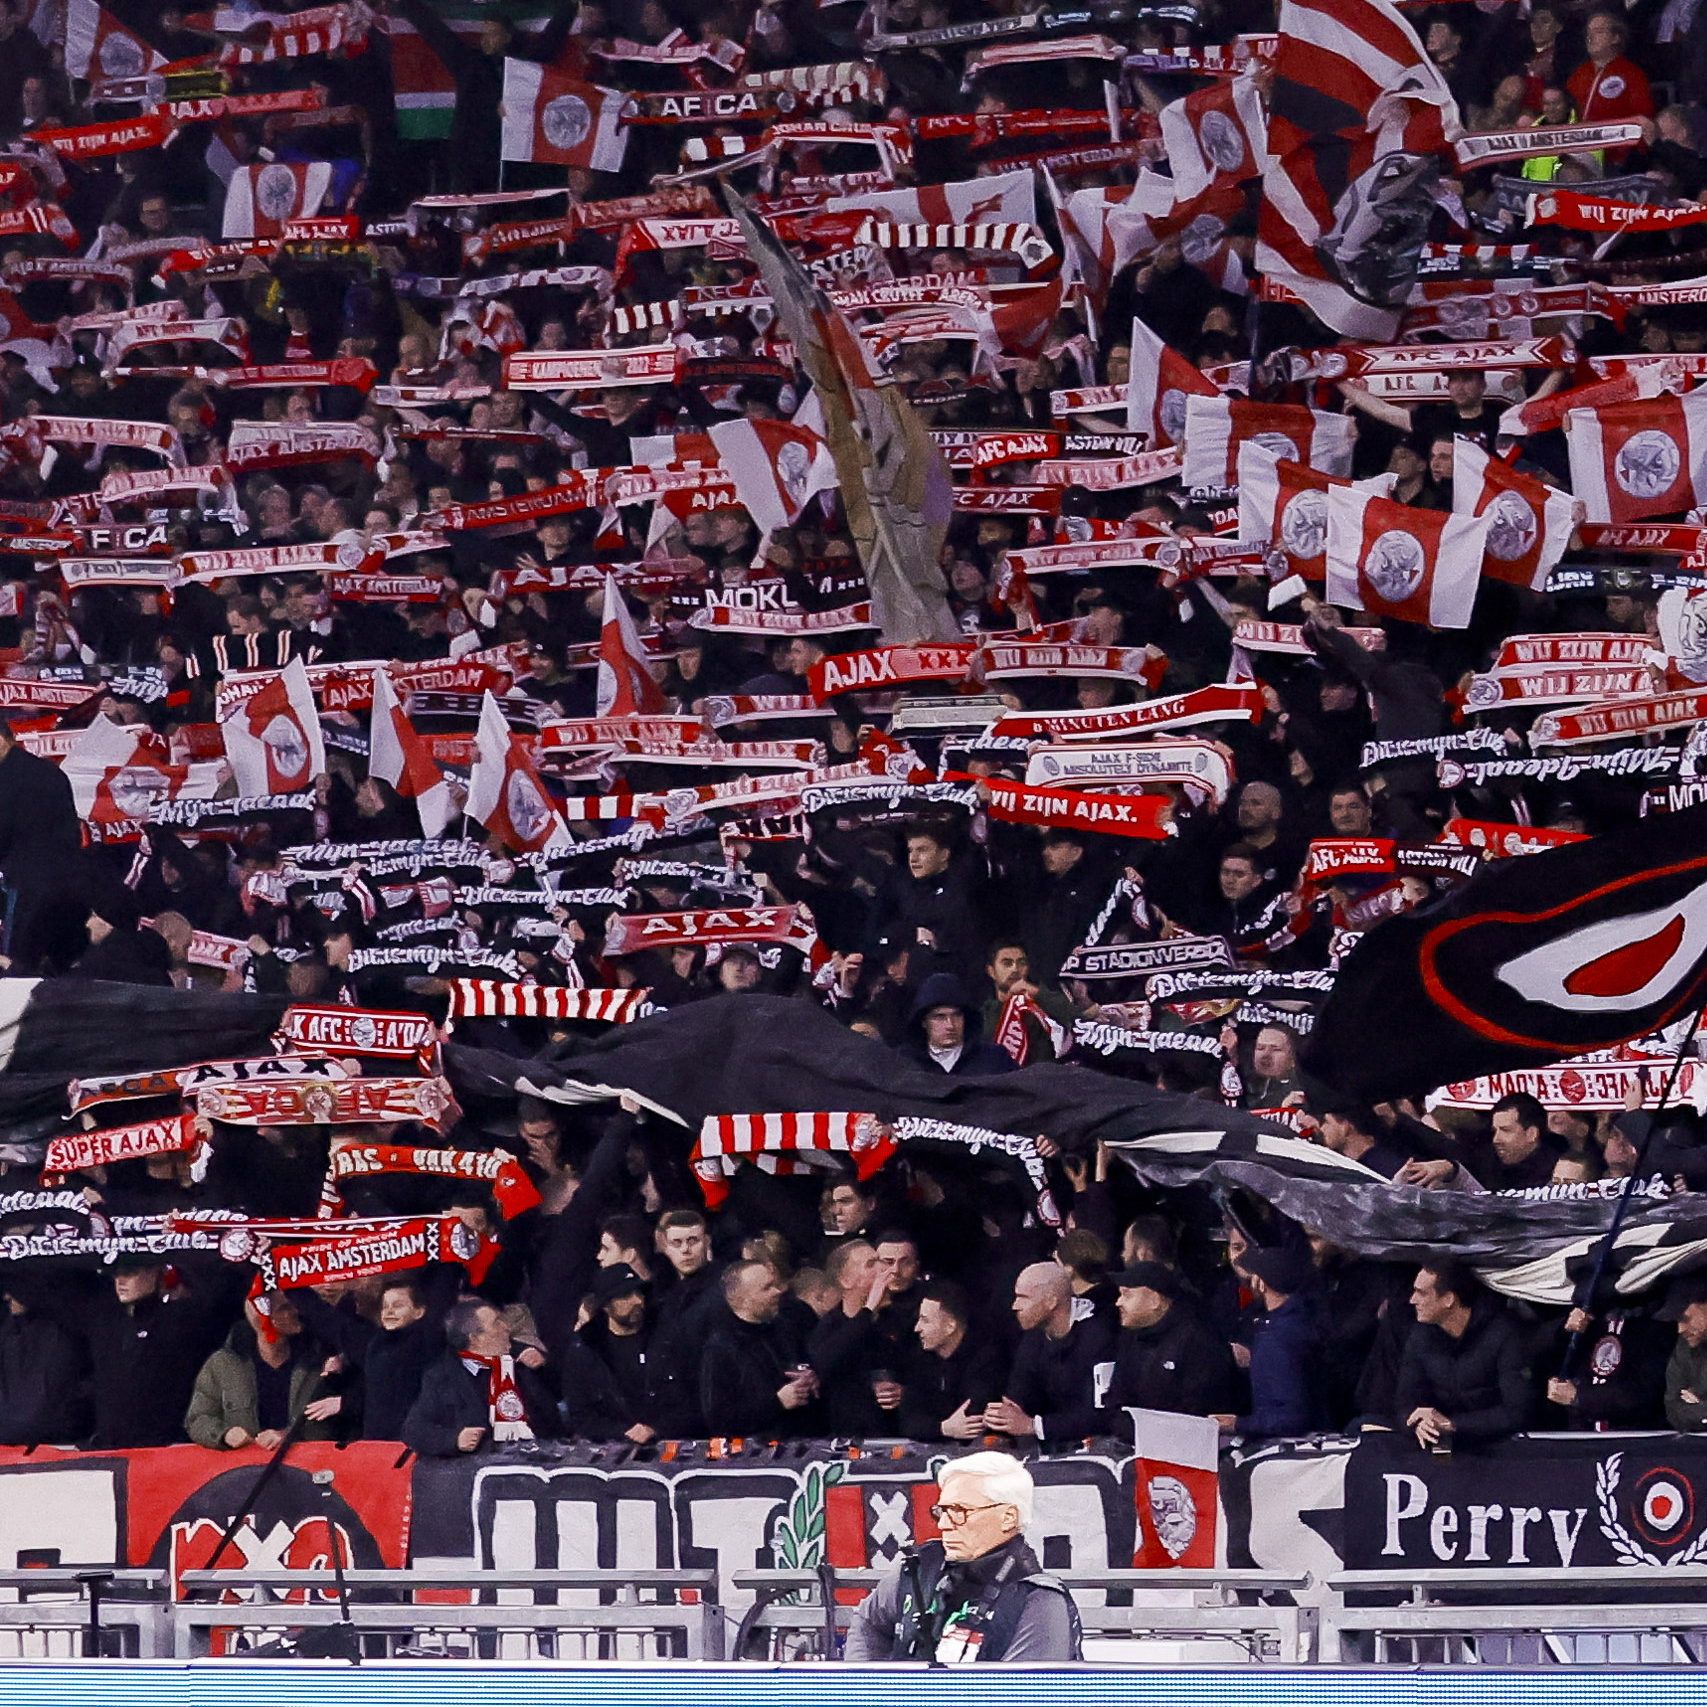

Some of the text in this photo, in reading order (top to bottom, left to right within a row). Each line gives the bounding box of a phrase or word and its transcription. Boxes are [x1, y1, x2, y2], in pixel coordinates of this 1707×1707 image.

[1579, 204, 1648, 223] WIJ ZIJN
[1455, 346, 1517, 360] AJAX
[977, 435, 1048, 465] AFC AJAX
[824, 648, 898, 692] AJAX
[331, 680, 371, 707] AJAX
[1137, 699, 1186, 726] LANG
[1023, 792, 1138, 823] ZIJN AJAX.
[107, 819, 142, 837] AJAX
[643, 910, 778, 935] AJAX
[308, 1018, 341, 1043] AFC
[193, 1059, 331, 1085] AJAX
[50, 1122, 178, 1167] SUPER AJAX
[279, 1234, 427, 1281] AJAX AMSTERDAM
[1381, 1473, 1588, 1568] Perry
